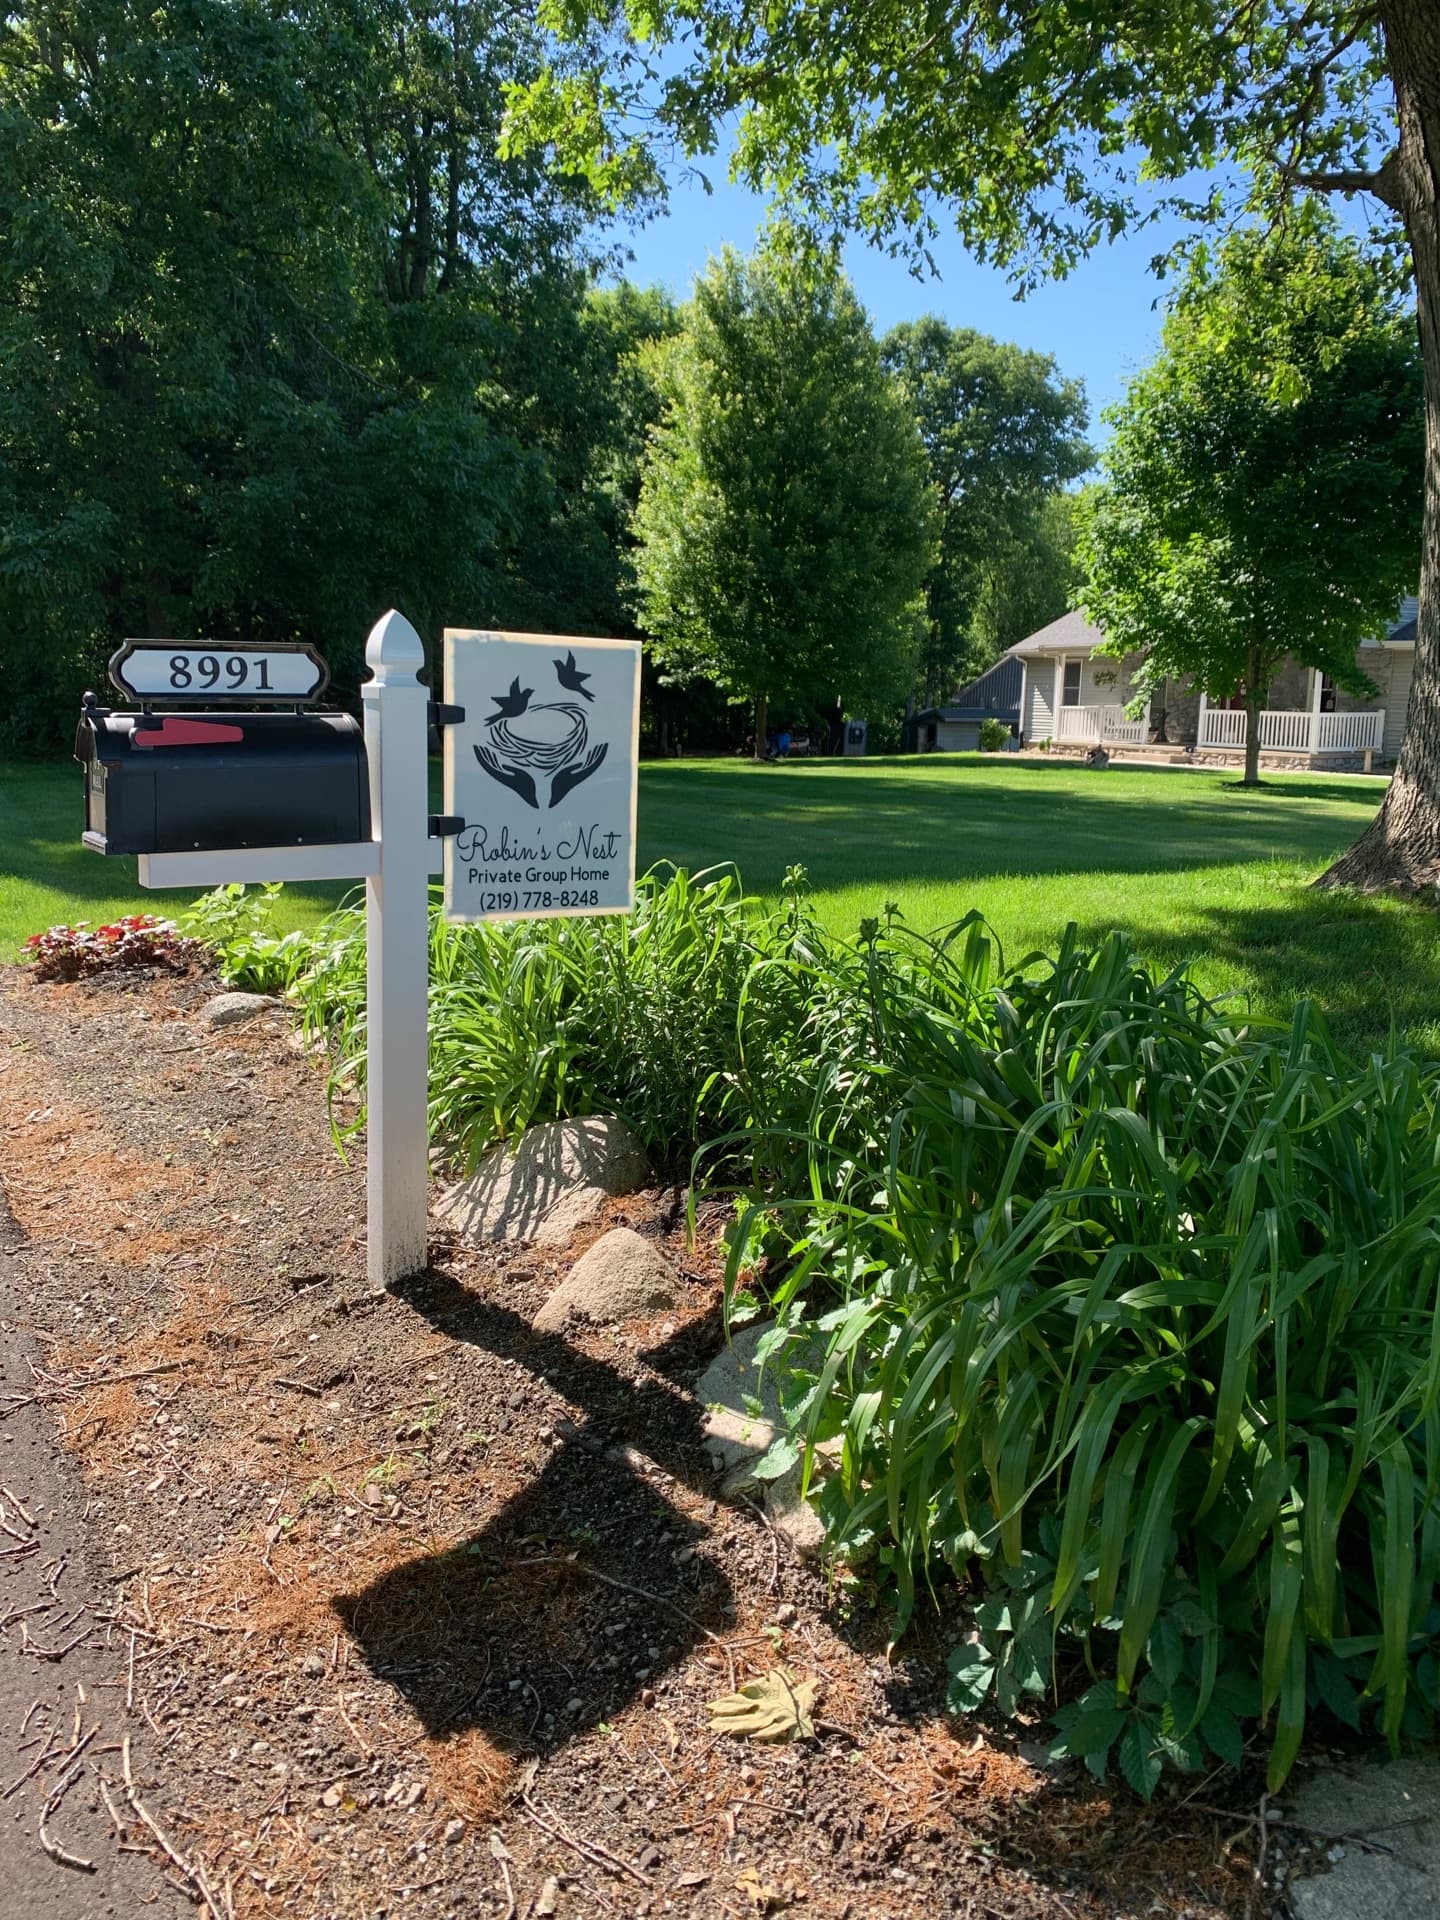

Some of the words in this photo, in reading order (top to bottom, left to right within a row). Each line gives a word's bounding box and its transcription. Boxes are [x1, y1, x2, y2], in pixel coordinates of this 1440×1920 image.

[169, 655, 274, 690] 8991
[456, 824, 551, 862] Robin's
[556, 823, 622, 860] Nest
[469, 868, 522, 884] Private
[525, 867, 568, 884] Group
[570, 866, 610, 881] Home
[480, 892, 518, 912] (219)
[522, 890, 599, 909] 778-8248
